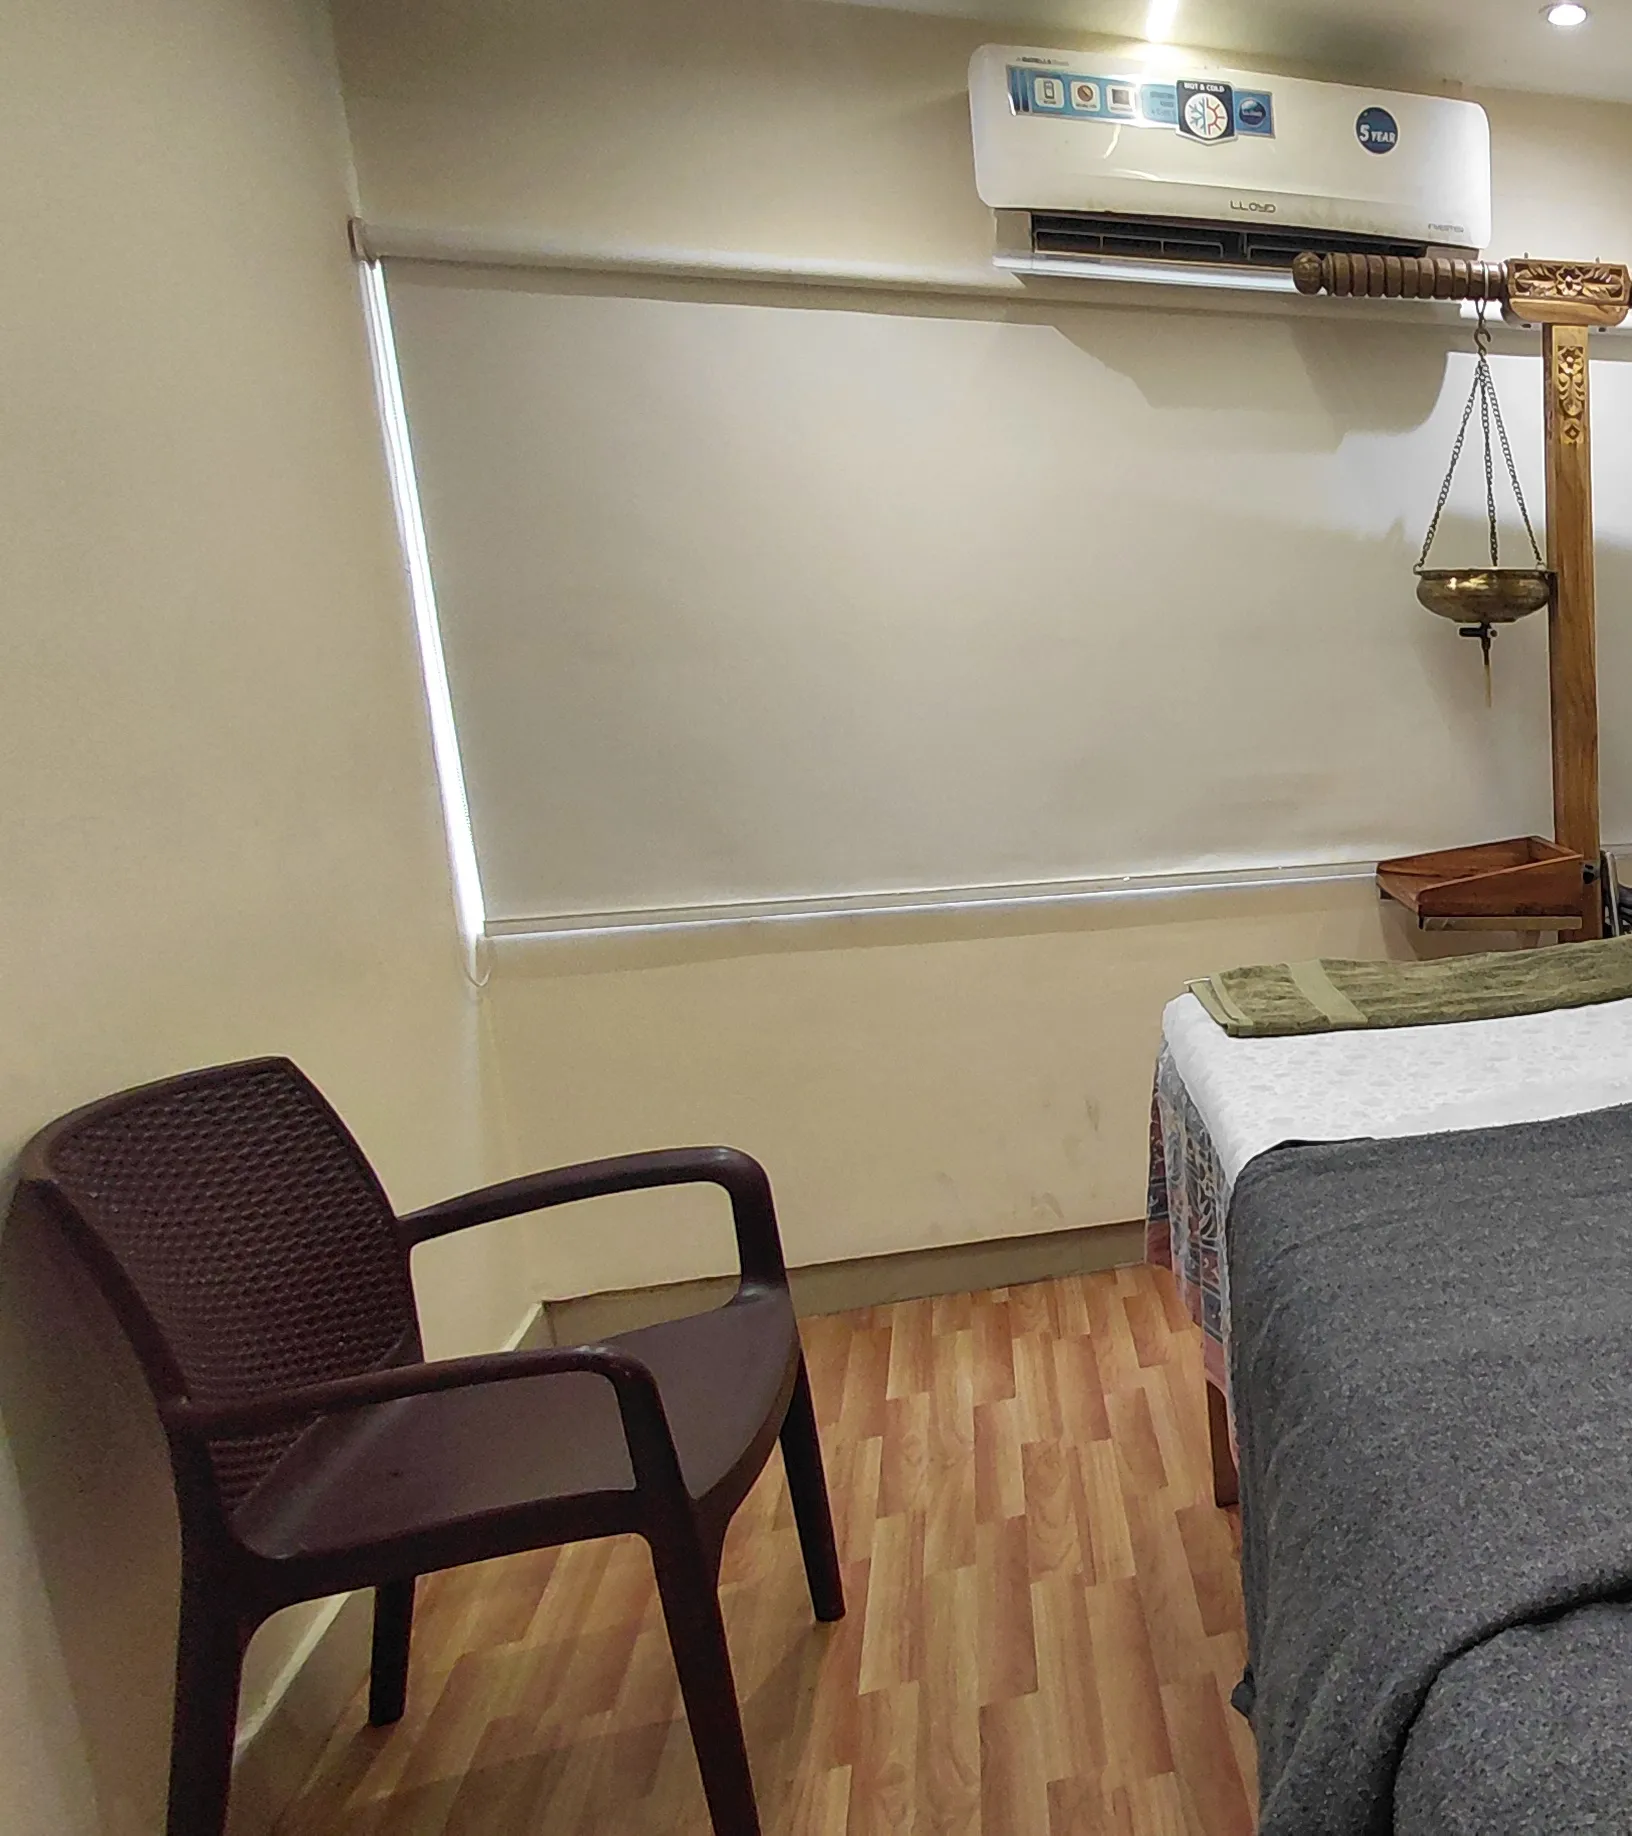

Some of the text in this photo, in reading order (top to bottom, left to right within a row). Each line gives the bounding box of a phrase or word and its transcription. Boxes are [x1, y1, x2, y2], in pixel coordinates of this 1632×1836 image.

[1183, 82, 1198, 91] HOT
[1206, 84, 1225, 93] COLD
[1359, 123, 1396, 143] 5 YEAR
[1229, 199, 1277, 214] LLOYD
